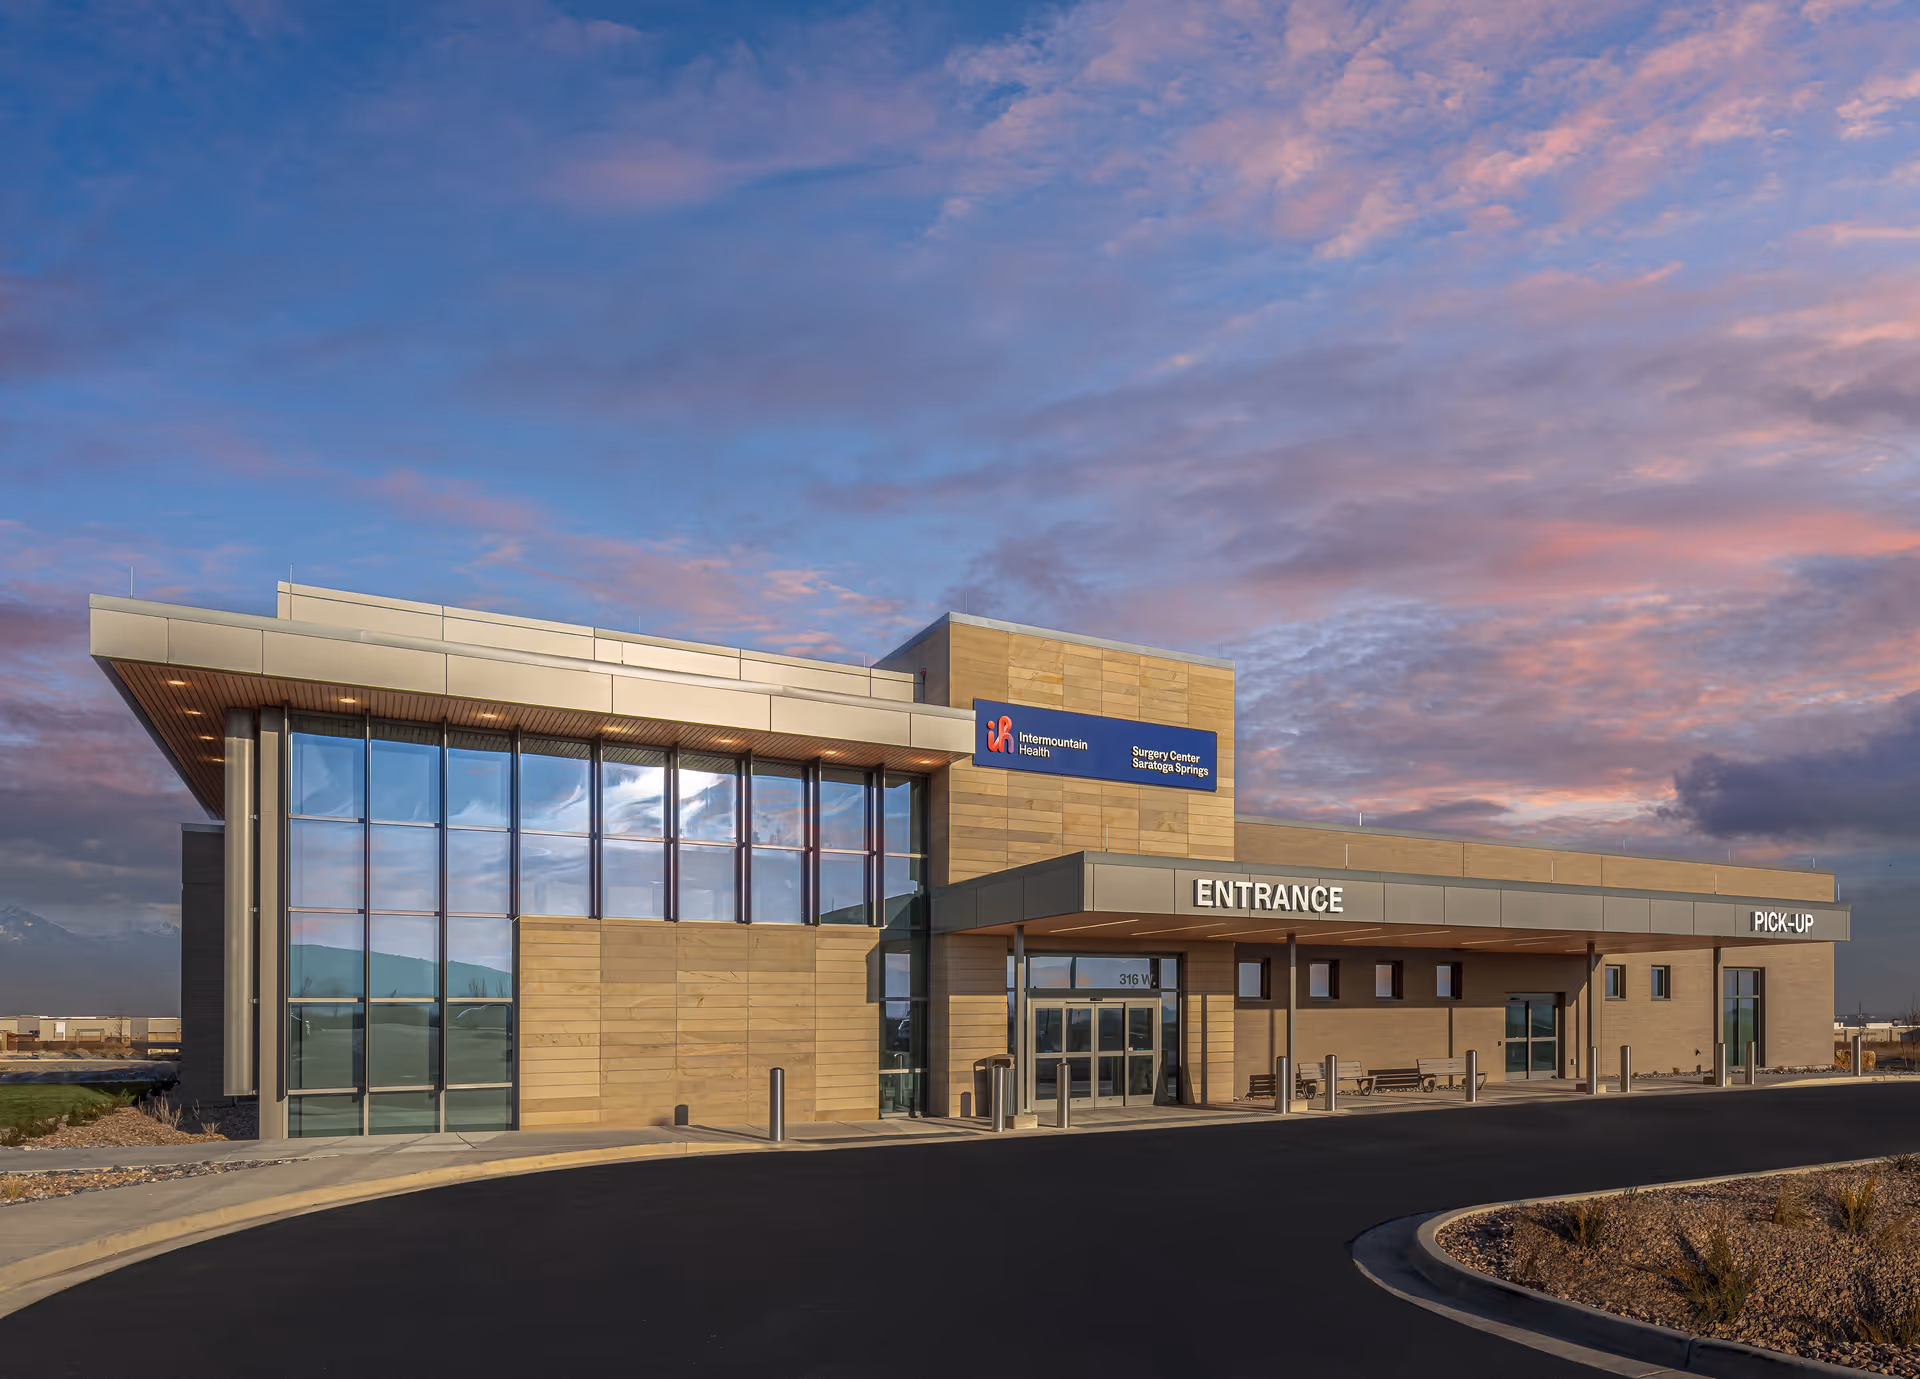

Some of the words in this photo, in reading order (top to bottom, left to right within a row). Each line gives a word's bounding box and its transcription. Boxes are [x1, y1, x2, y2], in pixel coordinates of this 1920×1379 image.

[1019, 732, 1087, 750] Intermountain
[1019, 744, 1050, 758] Health
[1132, 746, 1168, 763] Surgery
[1169, 751, 1201, 764] Center
[1132, 757, 1174, 773] Saratoga
[1174, 763, 1209, 777] Springs
[1194, 878, 1344, 913] ENTRANCE
[1753, 911, 1814, 933] PICK-UP
[1120, 973, 1139, 985] 316
